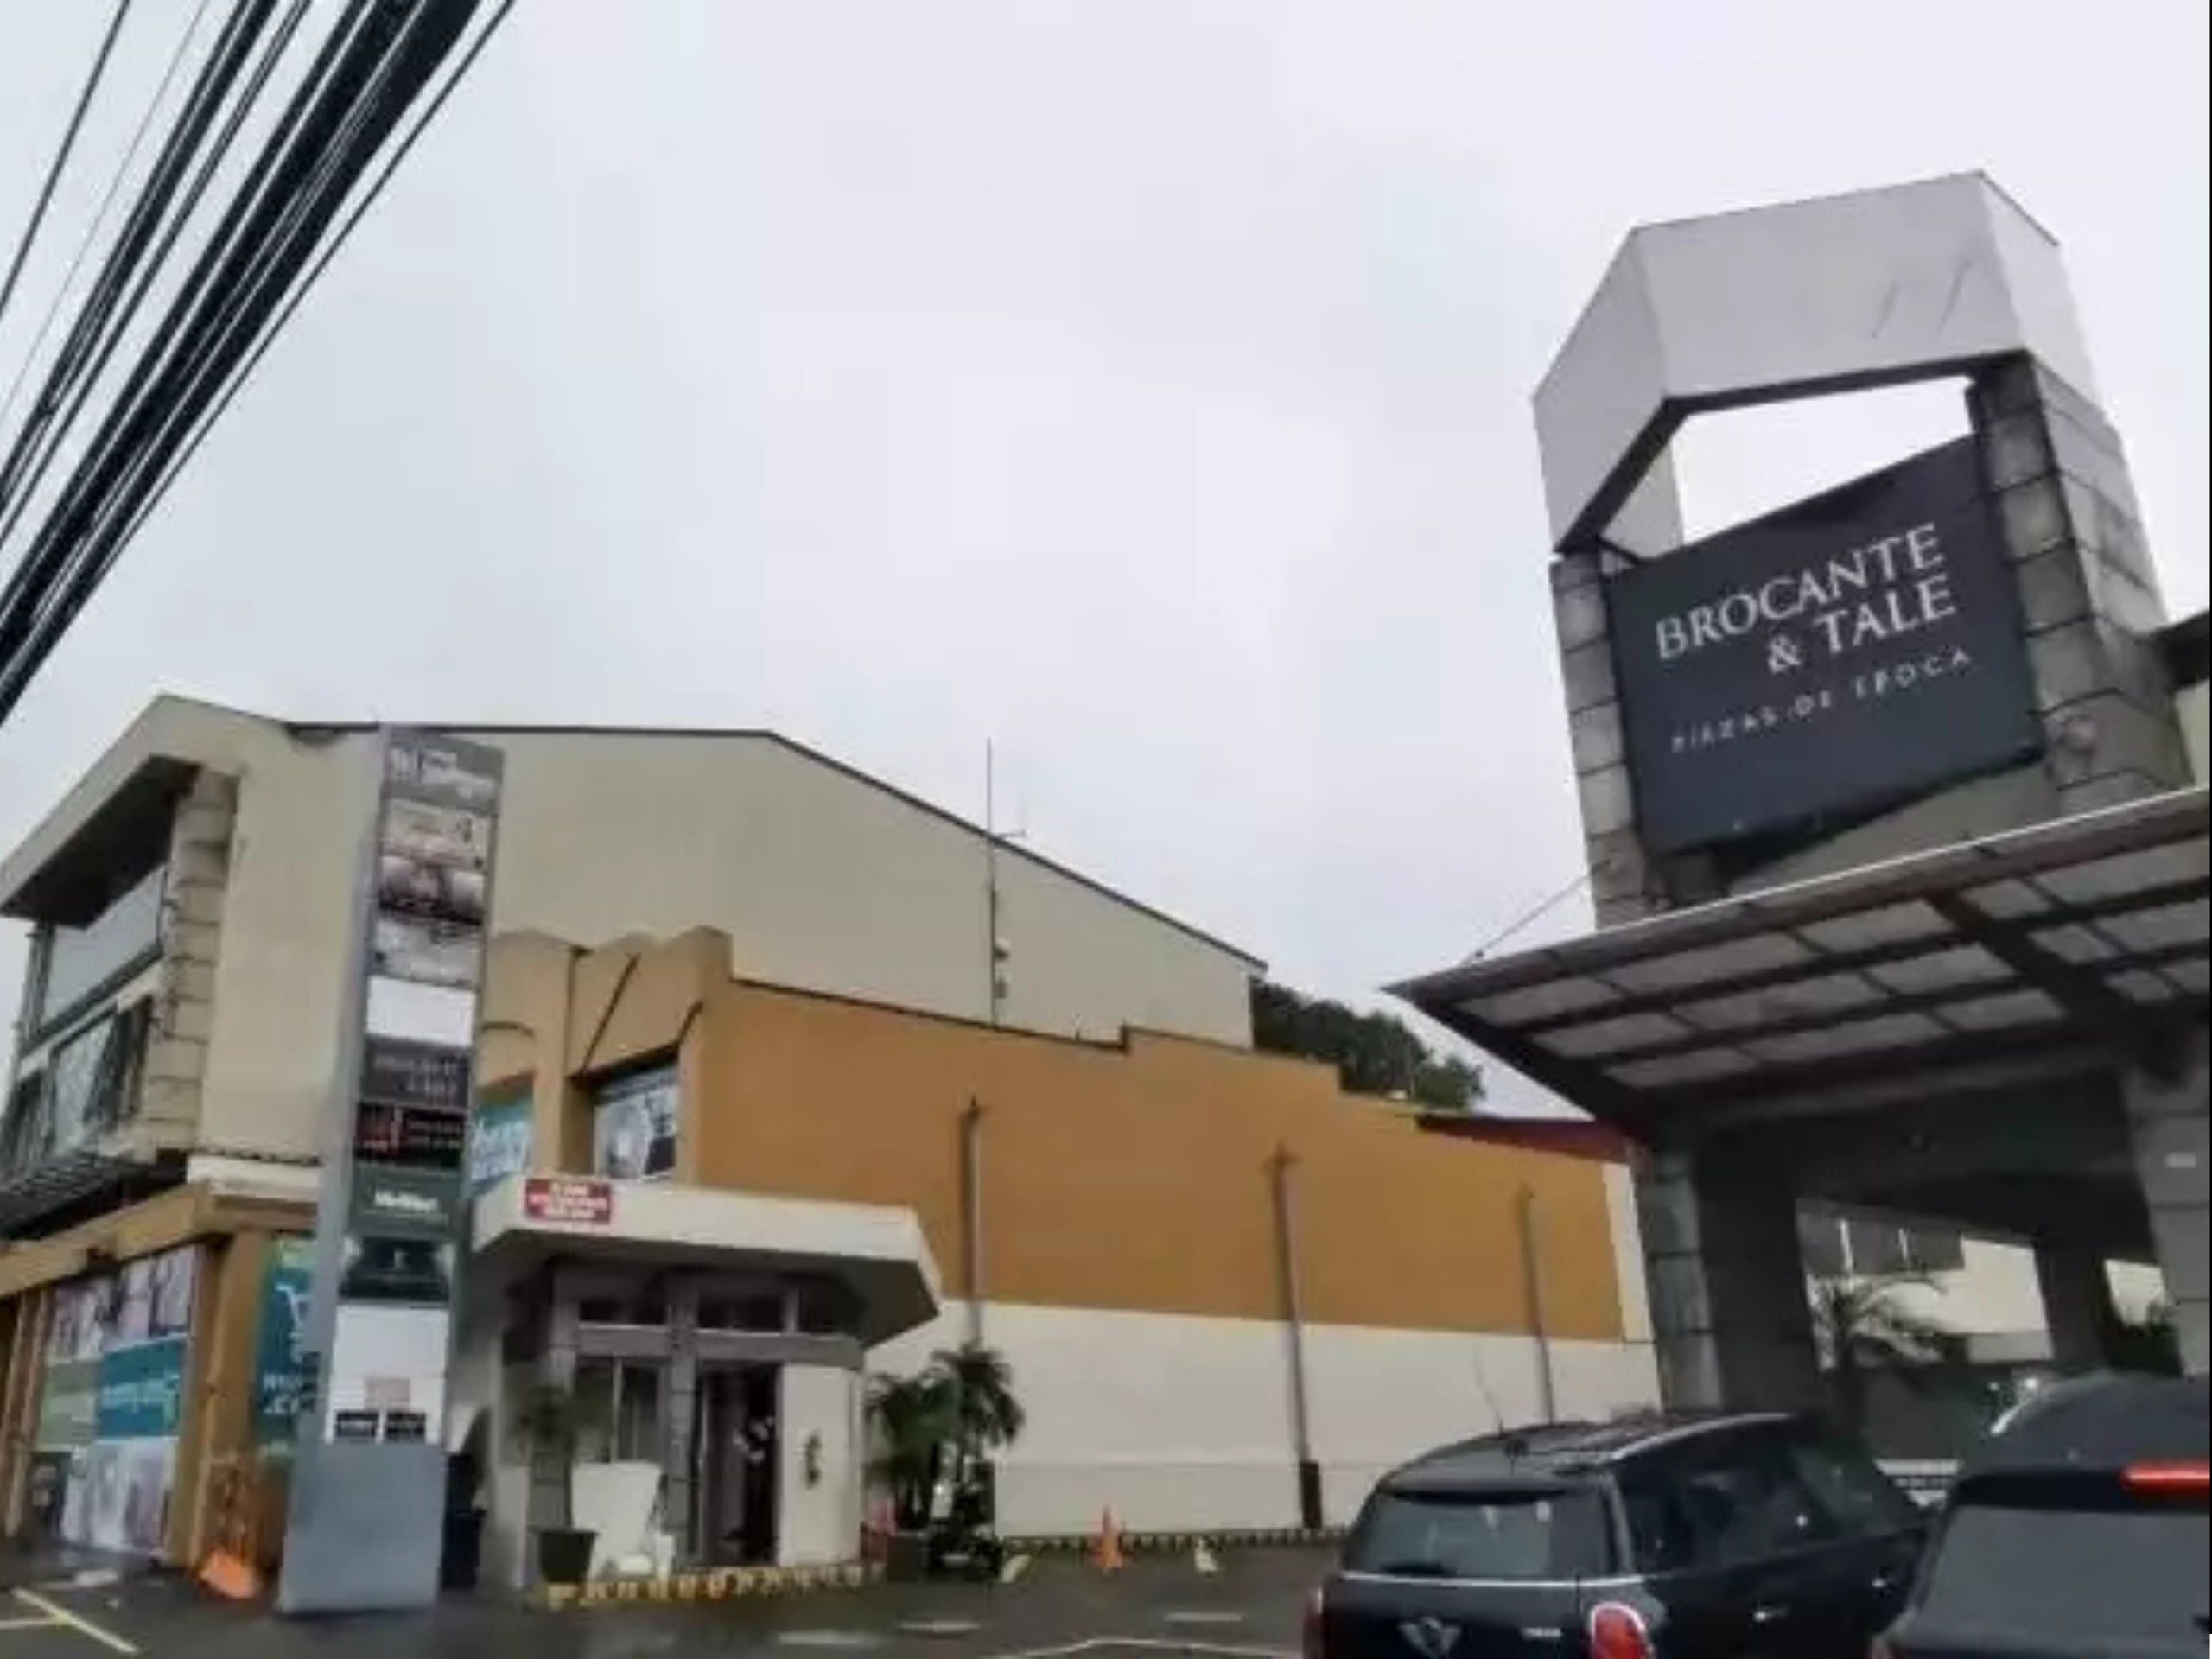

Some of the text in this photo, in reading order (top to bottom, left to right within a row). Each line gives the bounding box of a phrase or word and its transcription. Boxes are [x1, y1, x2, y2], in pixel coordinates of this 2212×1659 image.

[1654, 522, 1947, 661] BROCANTE
[1767, 575, 1957, 675] & TALE
